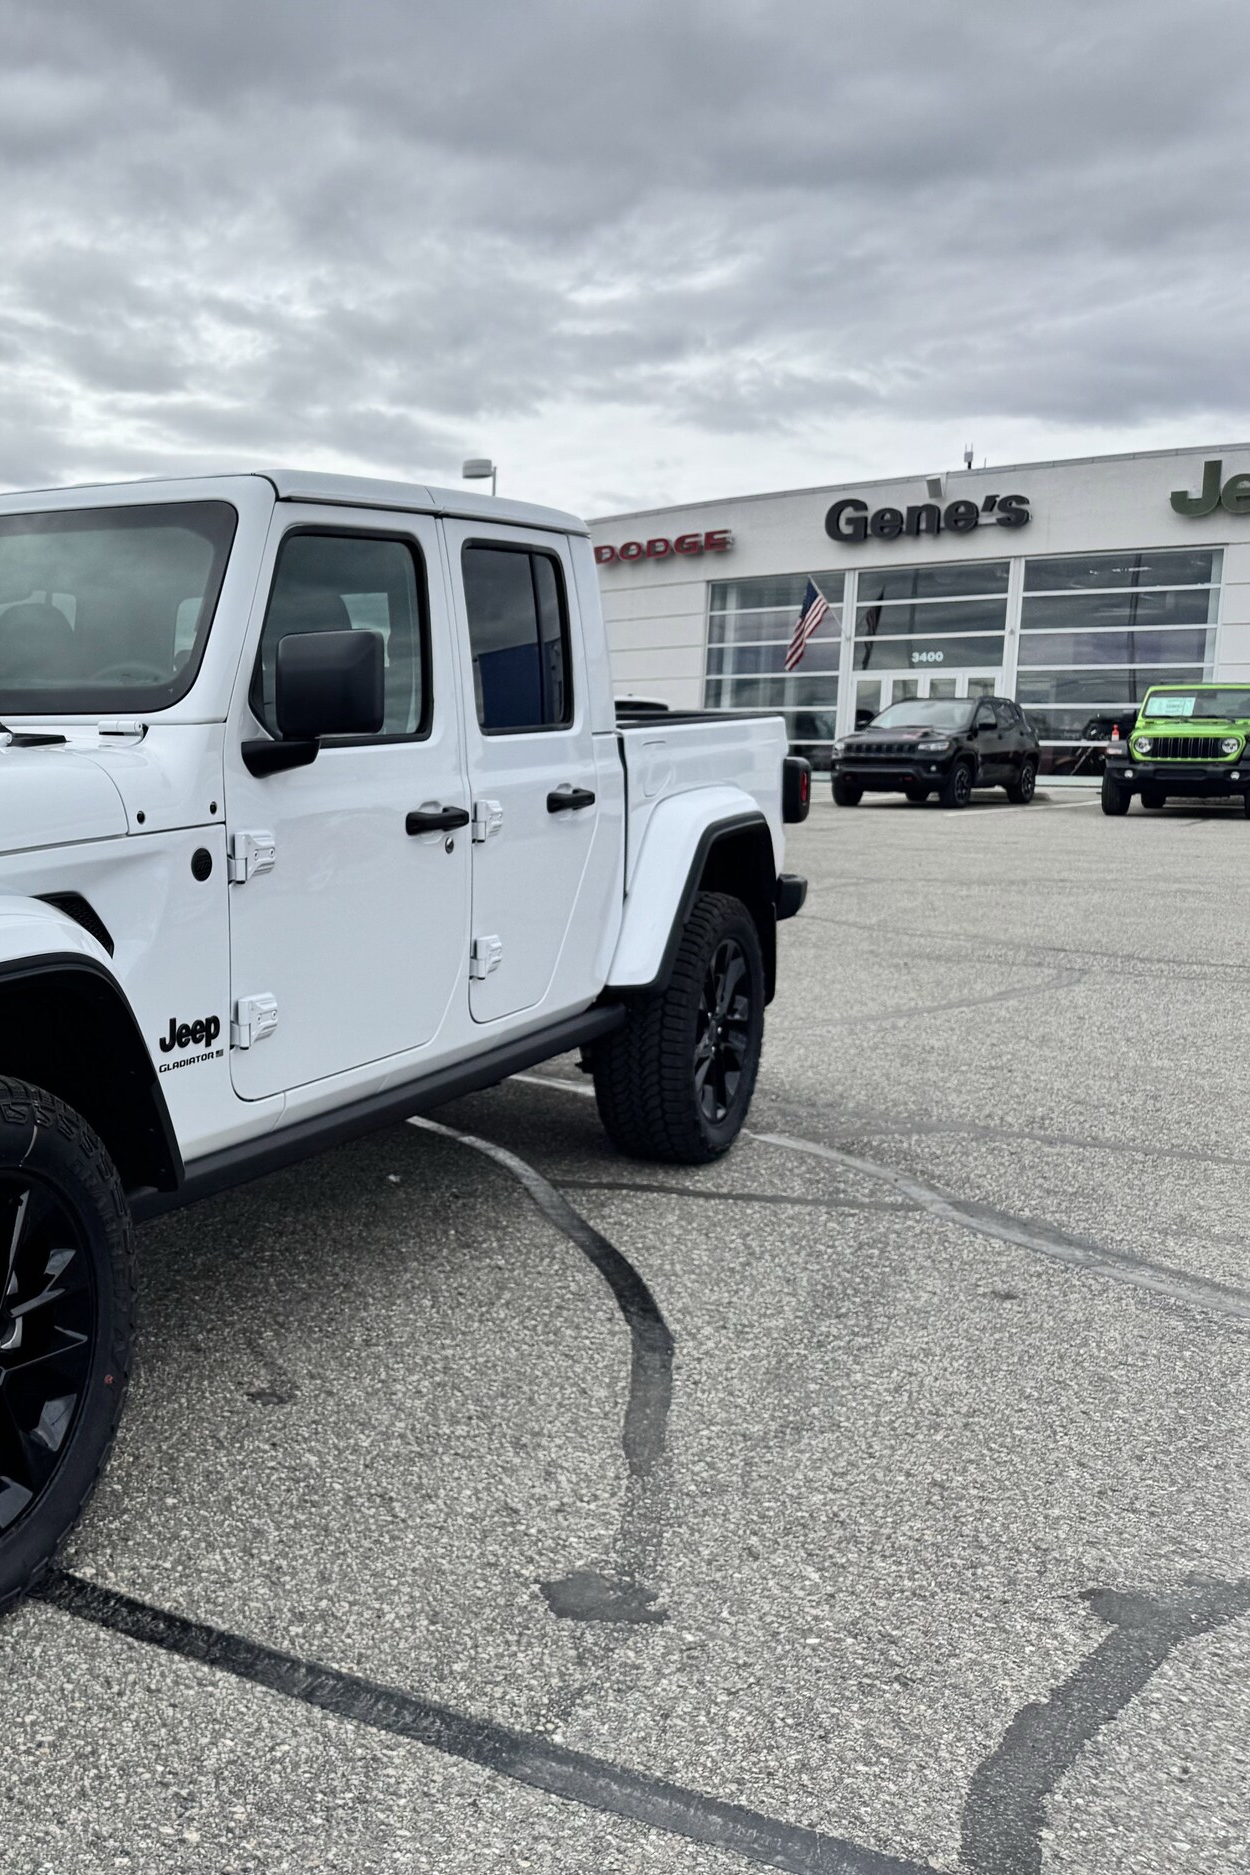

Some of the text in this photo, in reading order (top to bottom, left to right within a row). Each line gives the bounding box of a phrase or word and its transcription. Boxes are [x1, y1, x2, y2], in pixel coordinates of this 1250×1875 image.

[825, 494, 1031, 542] Gene's
[594, 529, 731, 564] DODGE
[911, 651, 944, 663] 3400
[159, 1015, 220, 1053] Jeep
[158, 1051, 214, 1073] GLADIATOR
